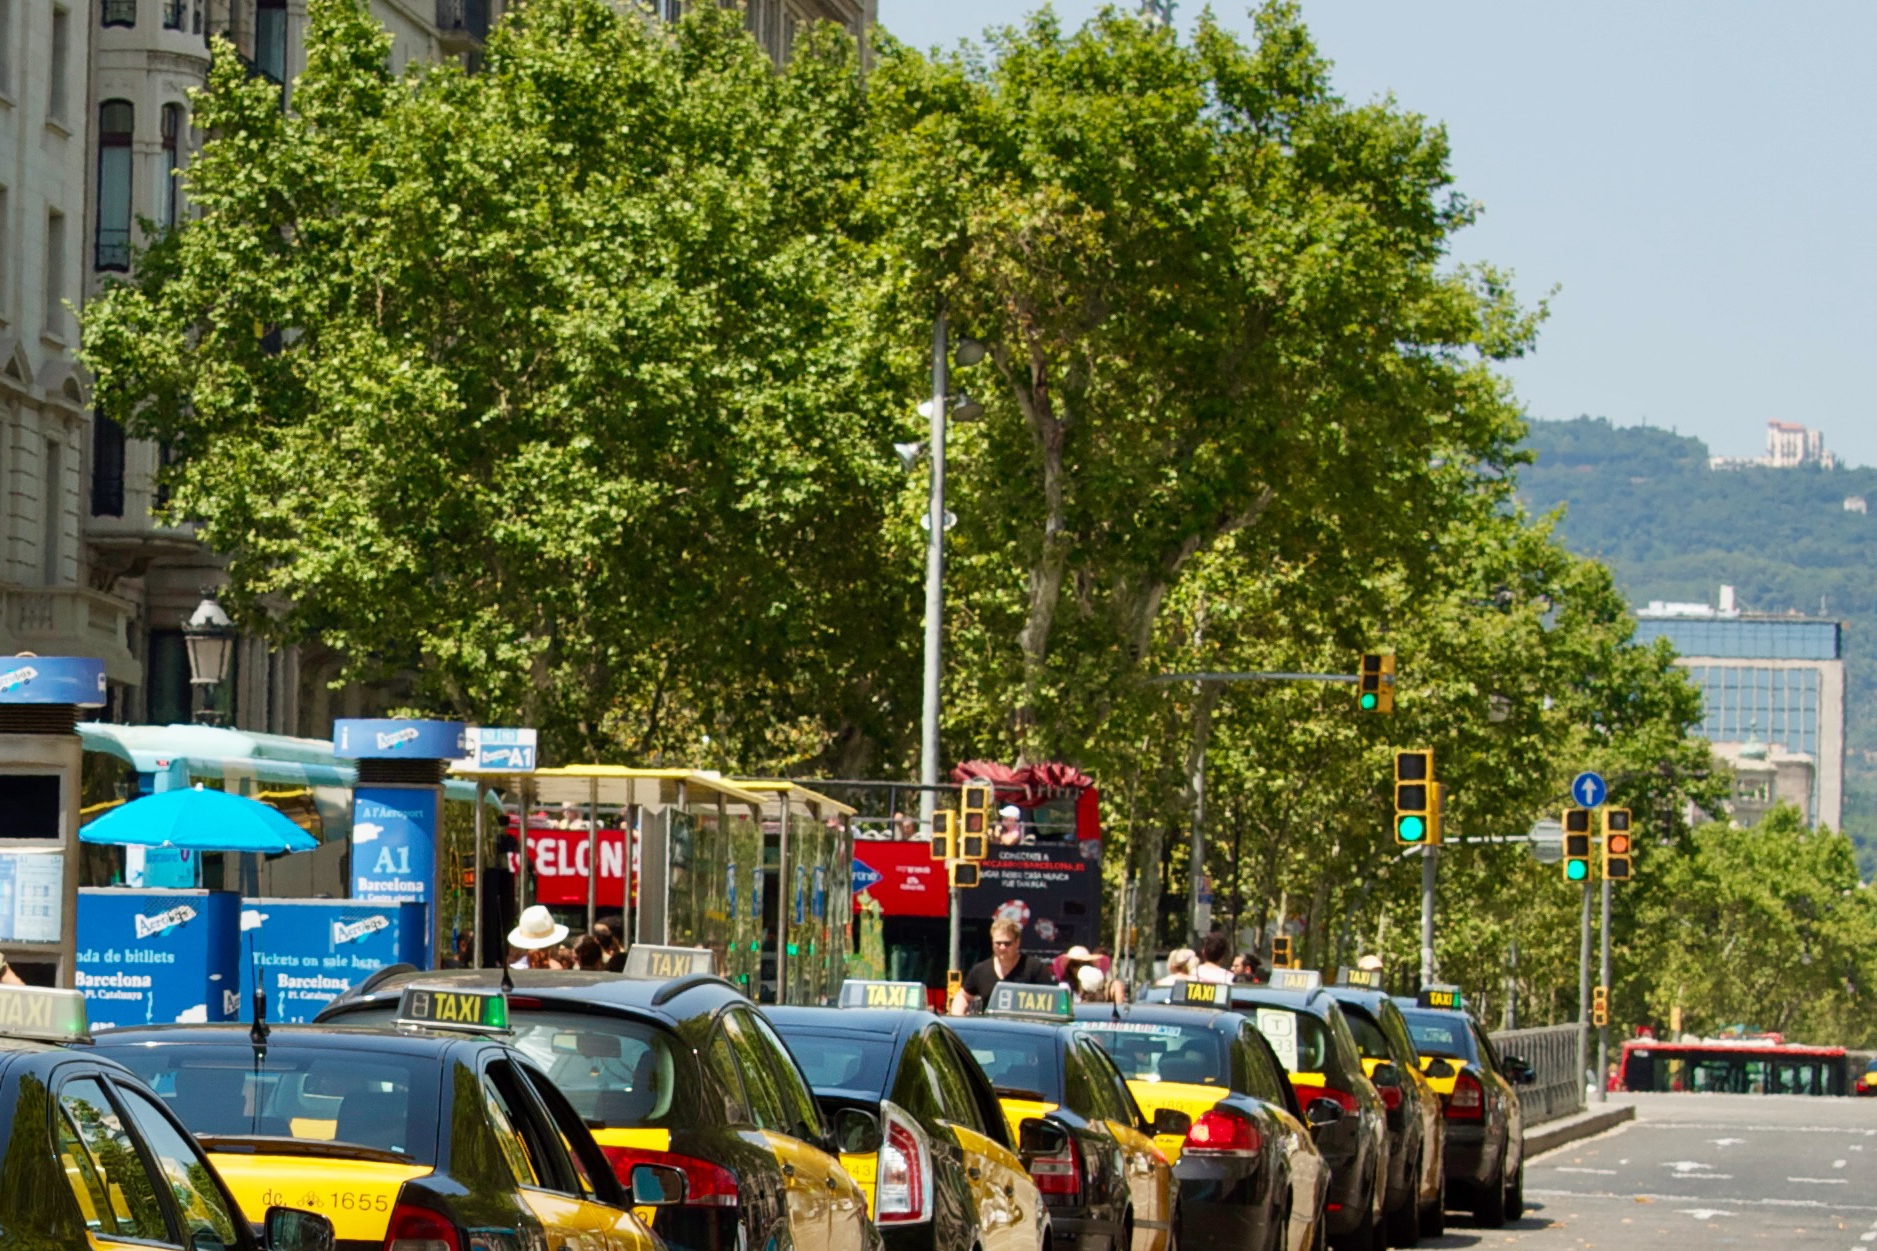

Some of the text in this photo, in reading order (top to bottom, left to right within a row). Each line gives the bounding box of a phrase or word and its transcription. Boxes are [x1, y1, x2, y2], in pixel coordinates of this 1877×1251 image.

[508, 748, 532, 767] A1
[374, 846, 411, 873] A1
[358, 877, 424, 892] Barcelona
[125, 949, 175, 964] bitllets
[253, 952, 381, 968] Tickets on sale here
[652, 952, 691, 976] TAXI
[76, 971, 152, 988] Barcelona
[277, 974, 350, 990] Barcelona
[1284, 974, 1308, 987] TAXI
[1349, 969, 1371, 985] TAXI
[866, 985, 906, 1005] TAXI
[1187, 983, 1215, 1001] TAXI
[1429, 992, 1452, 1006] TAXI
[434, 993, 481, 1022] TAXI
[1018, 992, 1053, 1011] TAXI
[331, 1192, 388, 1211] 1655
